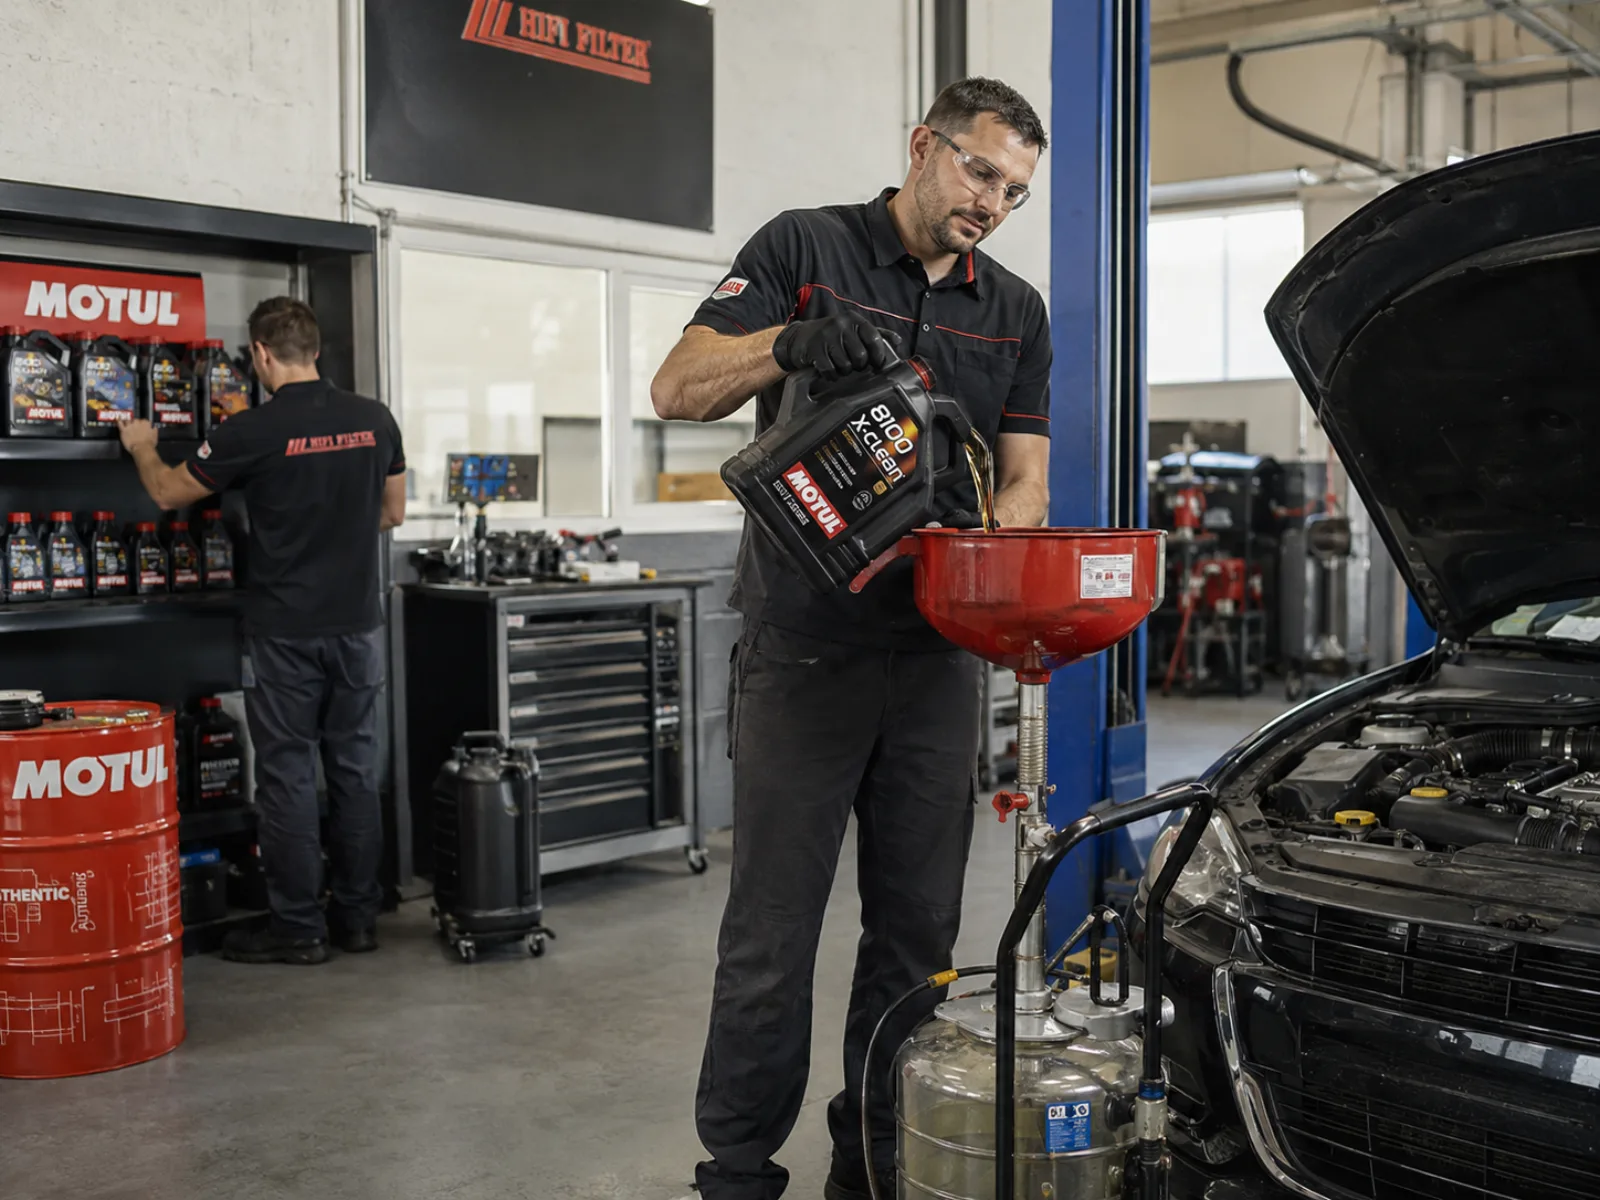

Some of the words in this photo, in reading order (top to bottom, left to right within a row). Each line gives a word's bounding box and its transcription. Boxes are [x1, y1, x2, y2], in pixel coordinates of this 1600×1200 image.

[519, 6, 569, 48] HIFI
[576, 22, 650, 68] FILTER
[24, 280, 180, 326] MOTUL
[870, 403, 914, 455] 8100
[787, 470, 841, 534] MOTUL
[12, 744, 168, 799] MOTUL
[0, 887, 70, 902] THENTIC
